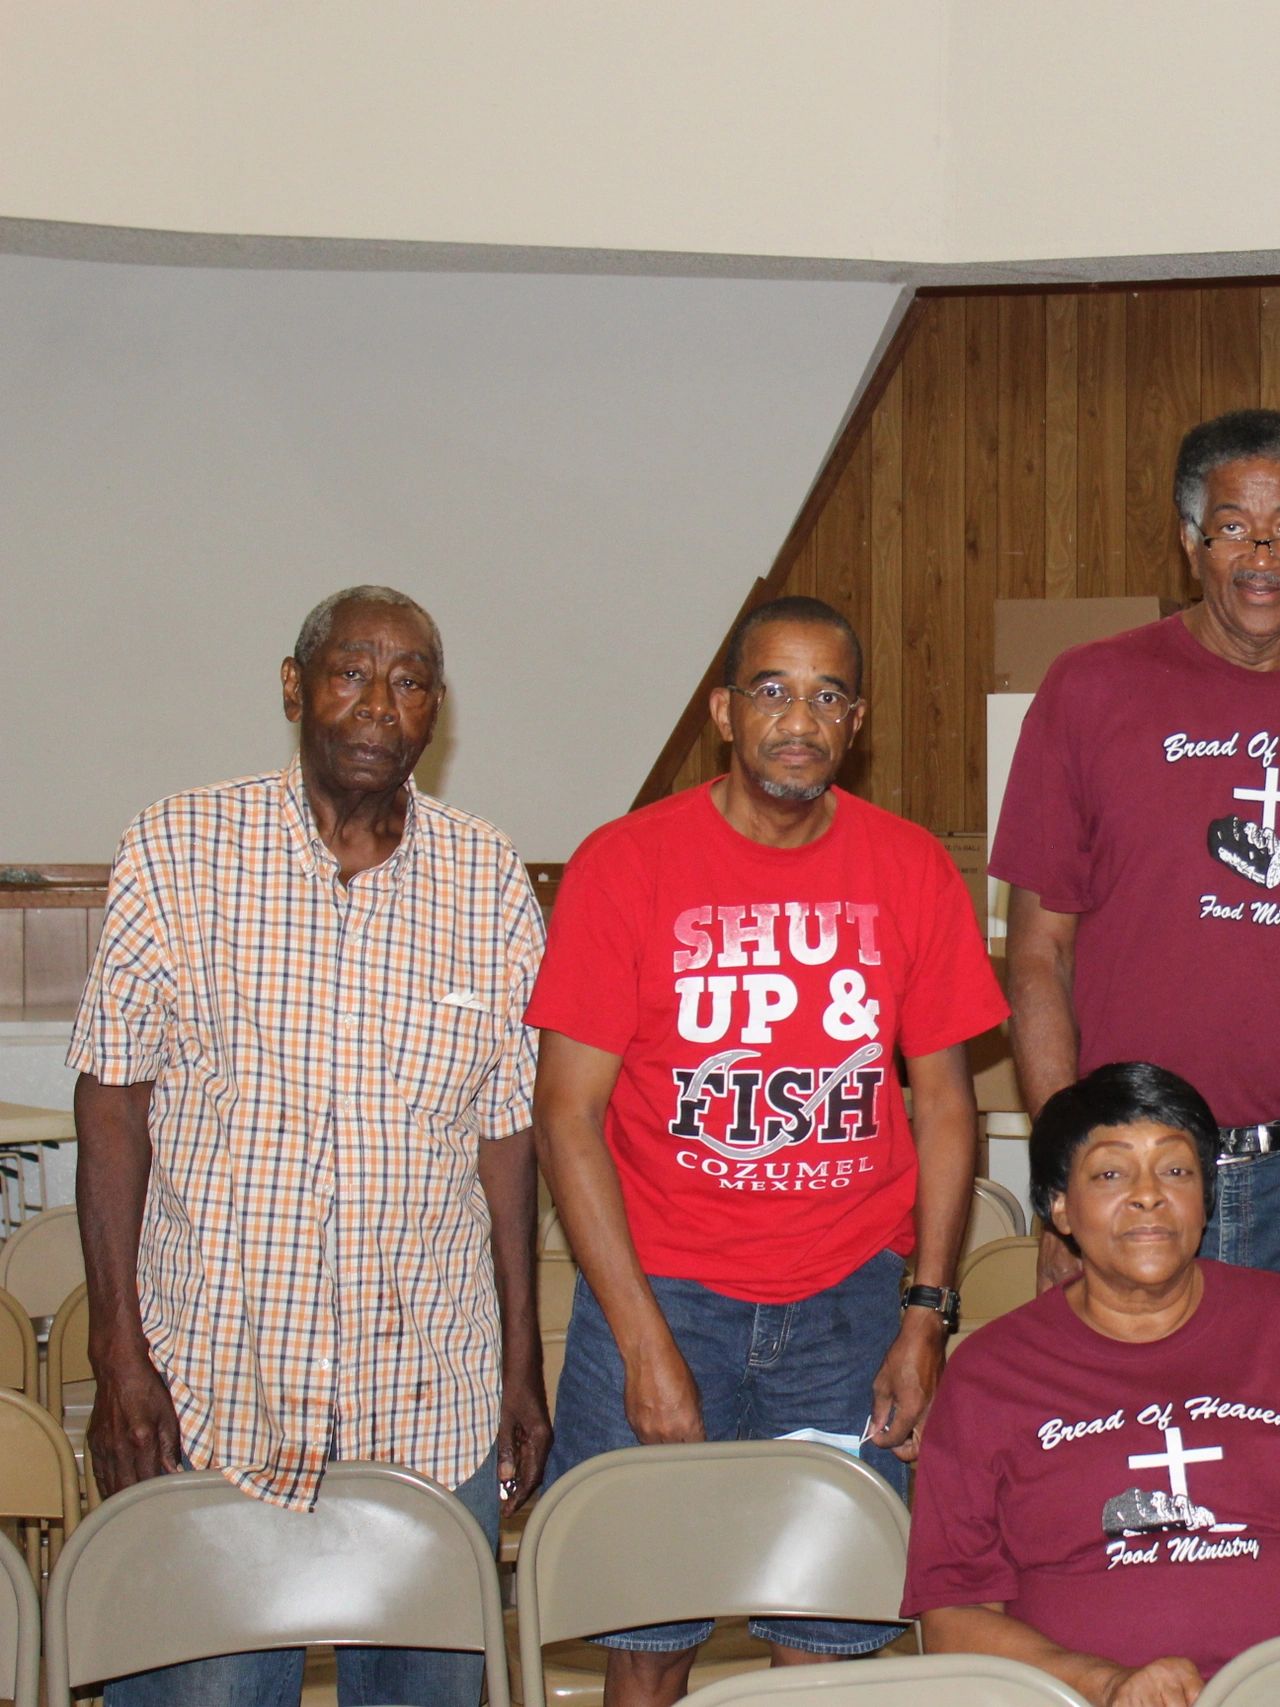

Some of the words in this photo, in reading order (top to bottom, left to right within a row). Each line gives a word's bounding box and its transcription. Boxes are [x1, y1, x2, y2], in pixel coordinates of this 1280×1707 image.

[1163, 731, 1240, 762] Bread
[1247, 731, 1279, 768] Of
[1200, 894, 1245, 920] Food
[673, 901, 881, 973] SHUT
[674, 973, 799, 1044] UP
[822, 968, 880, 1041] &
[668, 1066, 884, 1146] FISH
[676, 1150, 874, 1180] COZUMEL
[719, 1177, 850, 1192] MEXICO
[1038, 1409, 1125, 1450] Bread
[1136, 1402, 1173, 1431] Of
[1106, 1540, 1160, 1570] Food
[1167, 1536, 1260, 1563] Ministry
